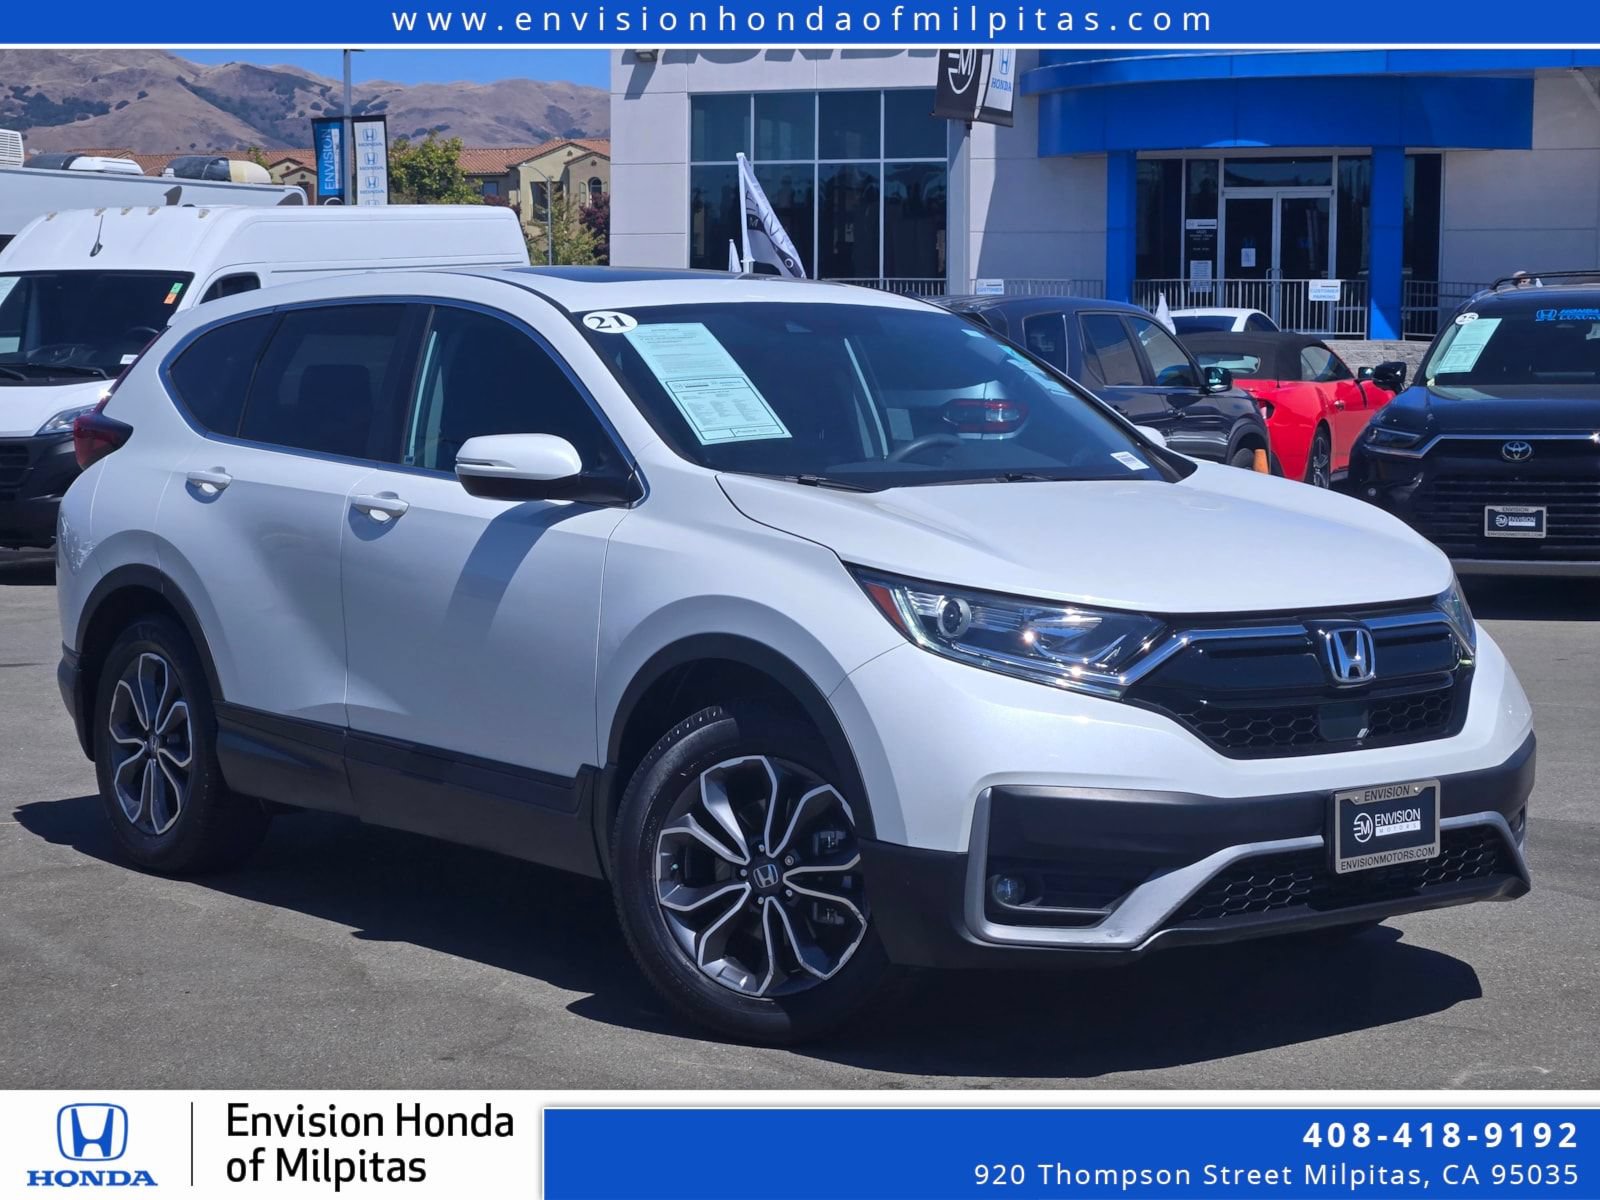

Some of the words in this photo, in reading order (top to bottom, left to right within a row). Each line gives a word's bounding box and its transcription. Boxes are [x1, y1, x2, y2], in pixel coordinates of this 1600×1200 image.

[991, 77, 1012, 93] HONDA
[322, 127, 337, 190] ENVISION
[587, 314, 630, 330] 21
[1364, 784, 1411, 802] ENVISION
[1374, 807, 1421, 827] ENVISION
[1379, 822, 1418, 834] MOTORS
[1340, 846, 1436, 871] ENVISIONMOTORS.COM
